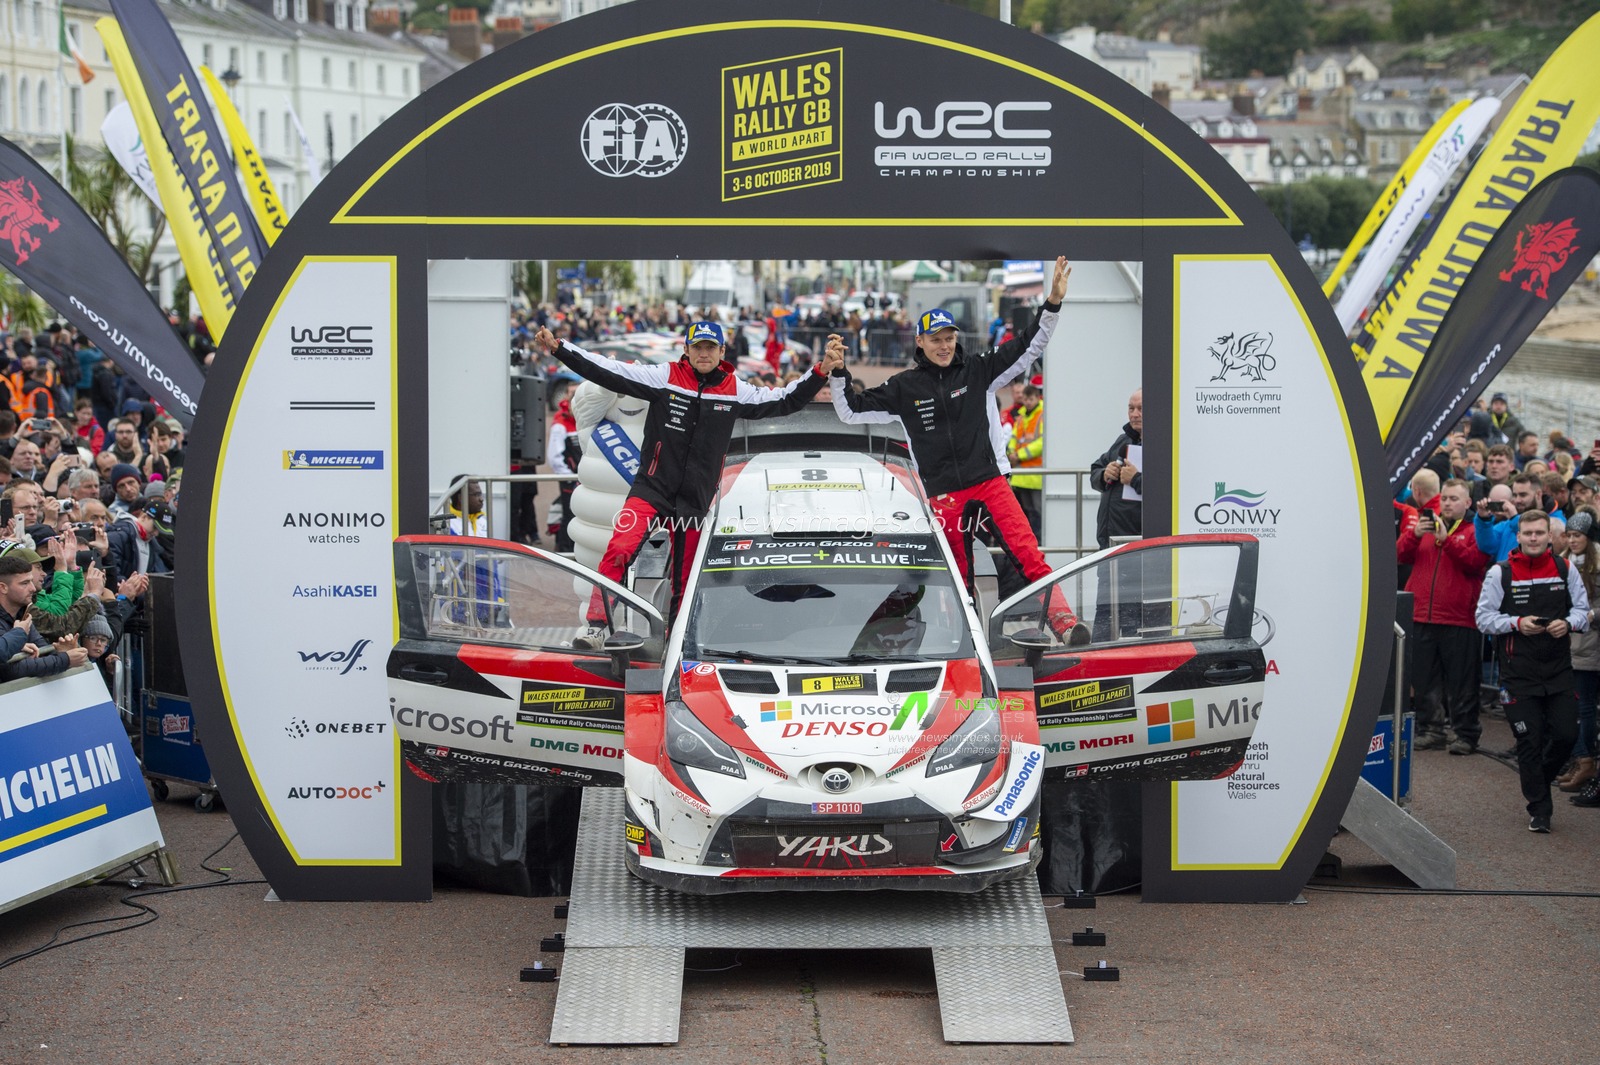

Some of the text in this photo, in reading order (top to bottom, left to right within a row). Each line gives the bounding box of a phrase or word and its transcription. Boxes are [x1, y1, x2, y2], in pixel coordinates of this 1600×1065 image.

[732, 61, 831, 110] WALES
[734, 98, 831, 138] RALLY GB
[874, 101, 1052, 138] WRC
[738, 130, 826, 156] A WORLD APART
[880, 152, 1046, 160] FIA WORLD RALLY
[732, 161, 832, 192] 3-6 OCTOBER 2019
[291, 326, 373, 343] WRC
[1196, 391, 1281, 404] Llywodraeth Cymru
[1196, 405, 1281, 414] Welsh Government
[310, 456, 376, 465] MICHELIN
[801, 469, 828, 481] 8
[282, 512, 385, 527] ANONIMO
[308, 532, 360, 543] watches
[756, 541, 816, 549] TOYOTA
[876, 541, 928, 550] Racing
[832, 553, 866, 563] ALL
[871, 553, 910, 564] LIVE
[292, 585, 378, 597] AsahiKASEI
[814, 680, 821, 690] 8
[527, 693, 550, 701] WALES
[550, 691, 570, 699] RALLY
[1043, 685, 1096, 704] WALES RALLY GB
[1075, 688, 1127, 708] A WORLD APART
[558, 700, 611, 711] A WORLD APART
[568, 719, 584, 727] Rally
[1063, 714, 1105, 724] Championship
[315, 722, 387, 733] ONEBET
[782, 721, 888, 738] DENSO
[530, 737, 580, 753] DMG
[1079, 733, 1134, 750] MORI
[1091, 760, 1140, 773] TOYOTA
[1143, 753, 1188, 765] GAZOO
[1189, 745, 1232, 758] Racing
[452, 752, 501, 765] TOYOTA
[503, 760, 549, 772] GAZOO
[549, 767, 593, 781] Racing
[720, 764, 740, 775] PIAA
[746, 756, 789, 780] DMG MORI
[885, 755, 926, 779] DMG MORI
[935, 763, 955, 773] PIAA
[0, 742, 121, 822] ICHELIN
[1228, 772, 1265, 781] Natural
[994, 750, 1041, 817] Panasonic
[1228, 782, 1280, 790] Resources
[287, 787, 373, 799] AUTODOC
[1228, 791, 1257, 800] Wales
[675, 790, 712, 816] KONECRANES
[819, 803, 861, 813] SP 1010
[626, 826, 645, 840] OMP
[777, 835, 893, 857] YARIS
